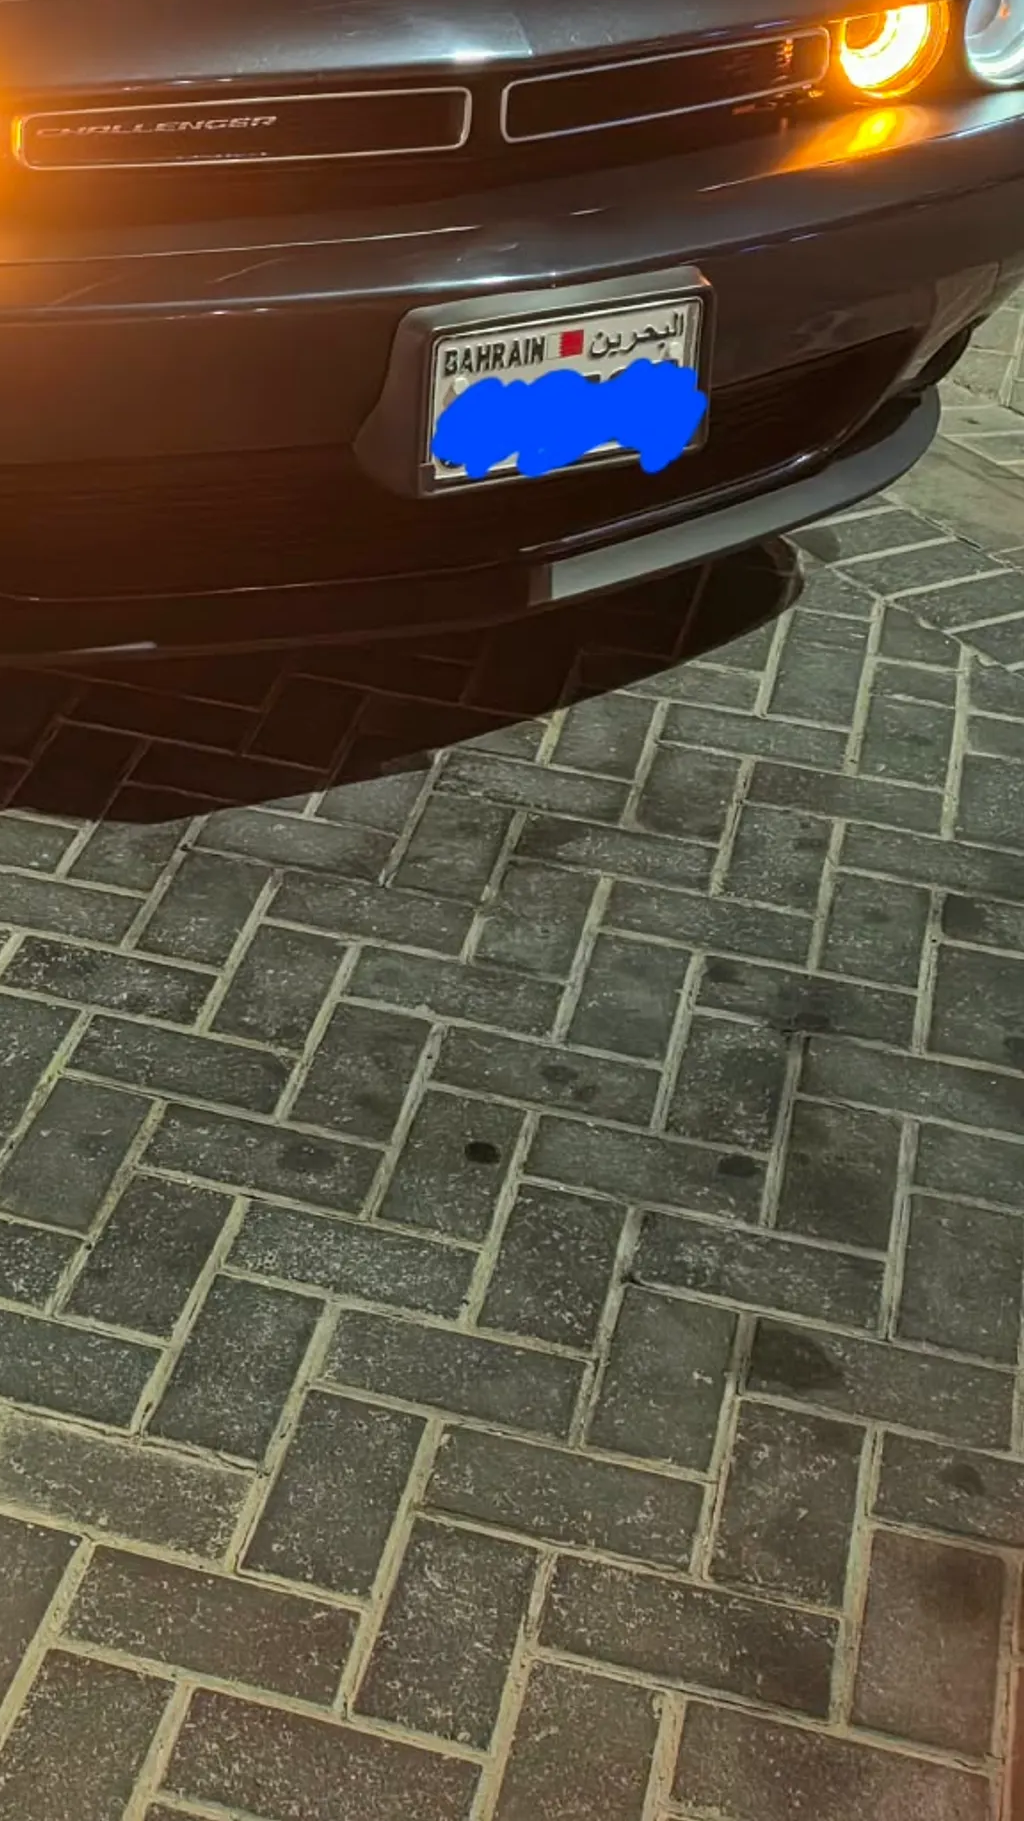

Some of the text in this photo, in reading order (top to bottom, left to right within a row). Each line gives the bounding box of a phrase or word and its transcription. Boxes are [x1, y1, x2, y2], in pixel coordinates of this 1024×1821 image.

[36, 115, 278, 138] CHALLENGER
[443, 335, 546, 376] BAHRAIN
[590, 311, 684, 359] البحرين
